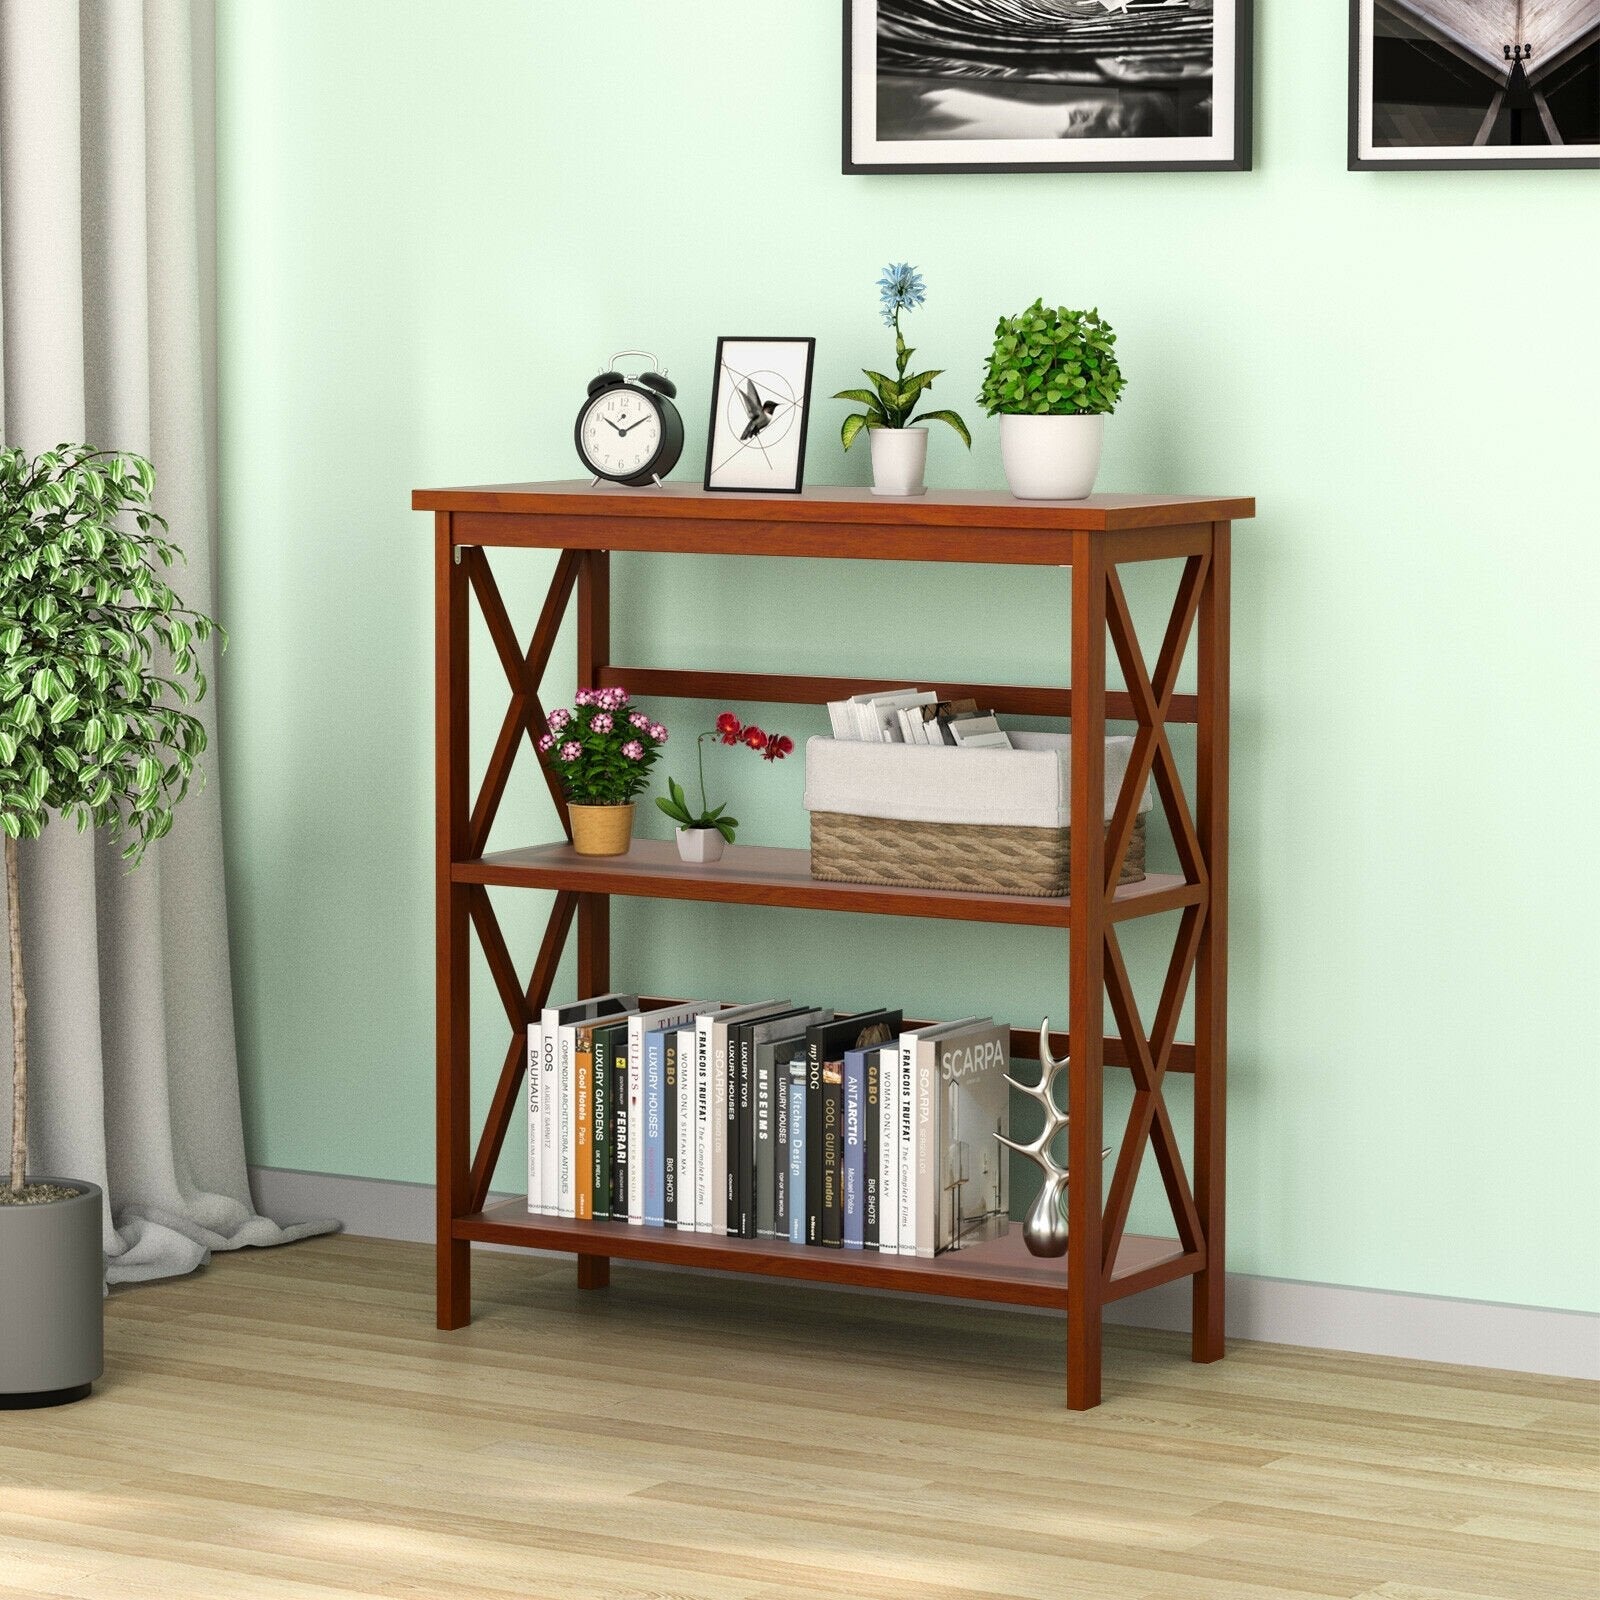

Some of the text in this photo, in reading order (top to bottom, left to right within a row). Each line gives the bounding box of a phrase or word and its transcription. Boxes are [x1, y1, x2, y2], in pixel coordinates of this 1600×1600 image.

[608, 402, 615, 410] 11
[620, 398, 630, 407] 12
[545, 1036, 553, 1072] LOOS
[649, 1046, 658, 1089] LUXURY
[667, 1048, 675, 1085] GABO
[808, 1044, 820, 1090] my DOG
[942, 1040, 1004, 1080] SCARPA
[715, 1050, 724, 1104] SCARPA
[868, 1067, 877, 1104] GABO
[920, 1068, 929, 1124] SCARPA
[649, 1093, 658, 1138] HOUSES
[759, 1070, 768, 1140] MUSEUMS
[848, 1076, 858, 1145] ANTARCTIC
[595, 1150, 600, 1158] UK
[617, 1111, 626, 1164] FERRARI
[791, 1093, 802, 1176] Kitchen Design
[825, 1099, 835, 1208] COOL GUIDE London
